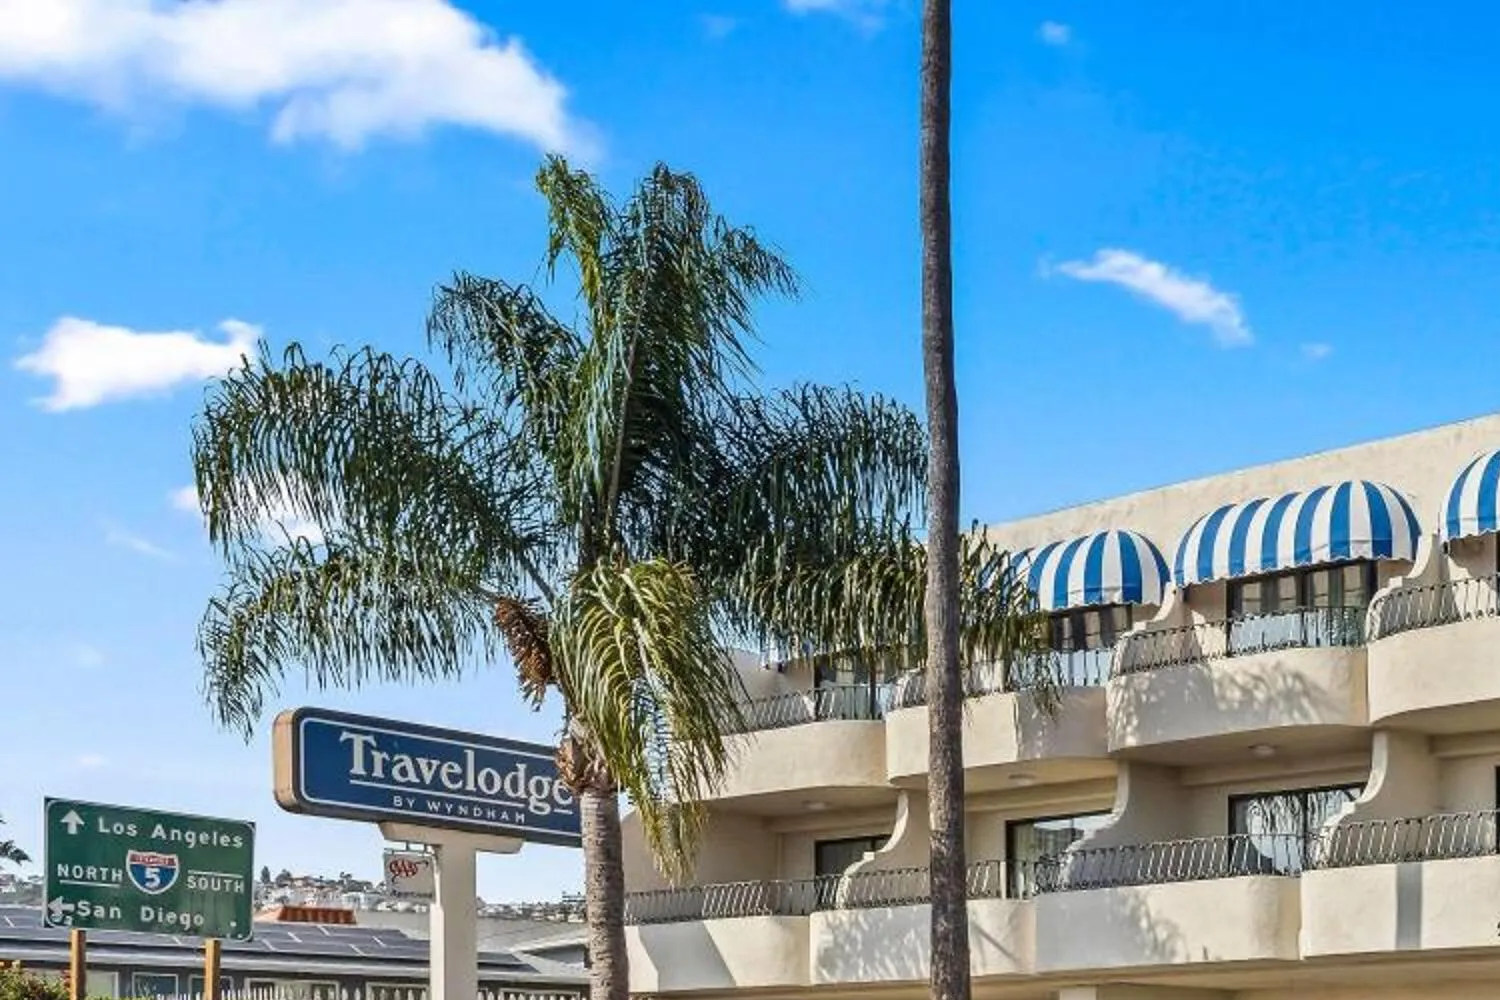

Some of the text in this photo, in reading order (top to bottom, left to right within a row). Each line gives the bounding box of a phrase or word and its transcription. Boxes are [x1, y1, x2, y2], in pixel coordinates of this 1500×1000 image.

[339, 731, 574, 815] Travelodge
[393, 796, 526, 824] BY WYNDHAM
[97, 815, 245, 848] Los Angeles
[57, 863, 124, 882] NORTH
[144, 868, 162, 889] 5
[186, 875, 245, 894] SOUTH
[76, 900, 206, 930] San Diego
